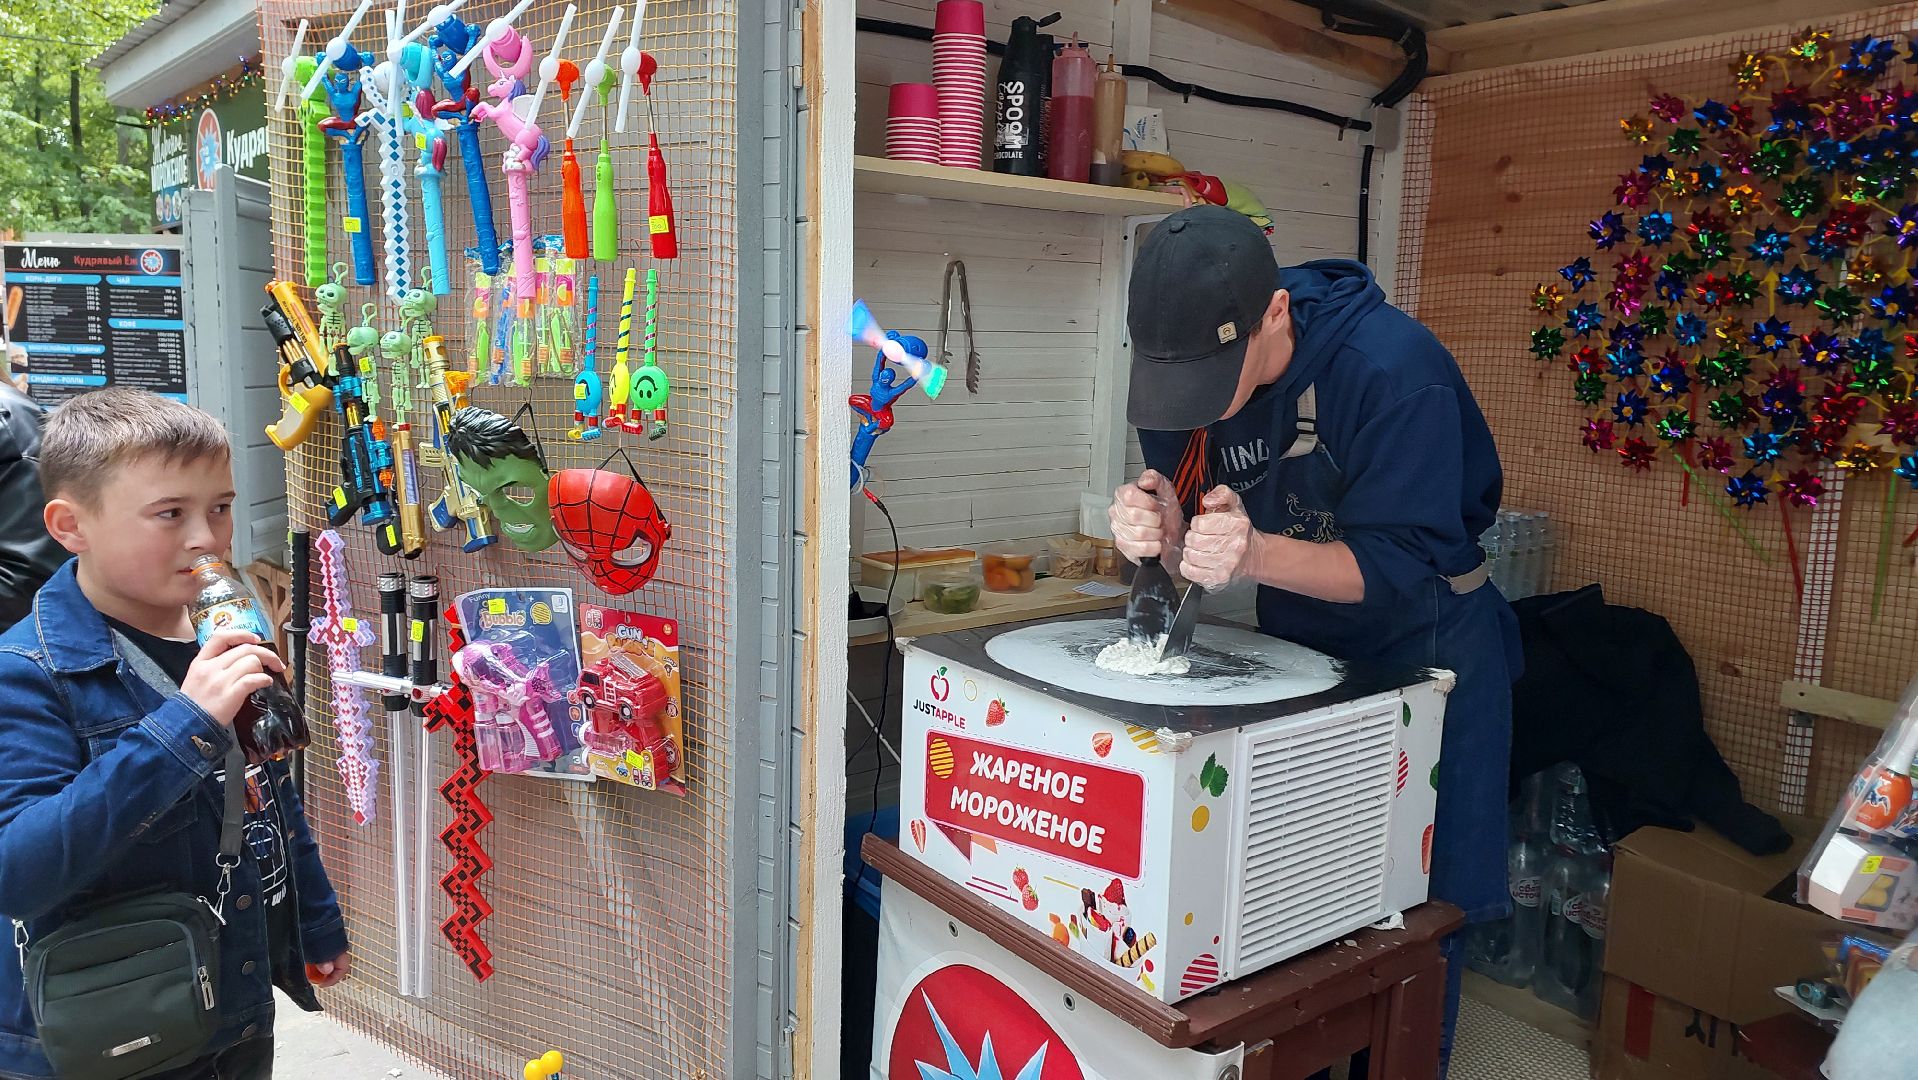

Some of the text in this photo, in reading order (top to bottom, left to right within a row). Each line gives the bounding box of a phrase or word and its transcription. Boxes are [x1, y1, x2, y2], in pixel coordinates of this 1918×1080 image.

[21, 248, 60, 268] Меню
[74, 255, 122, 267] Кудрявый
[481, 610, 526, 630] Bubble
[616, 623, 643, 641] GUN
[912, 698, 967, 730] JUSTAPPLE
[969, 751, 1088, 804] ЖАРЕНОЕ
[950, 786, 1106, 855] МОРОЖЕНОЕ
